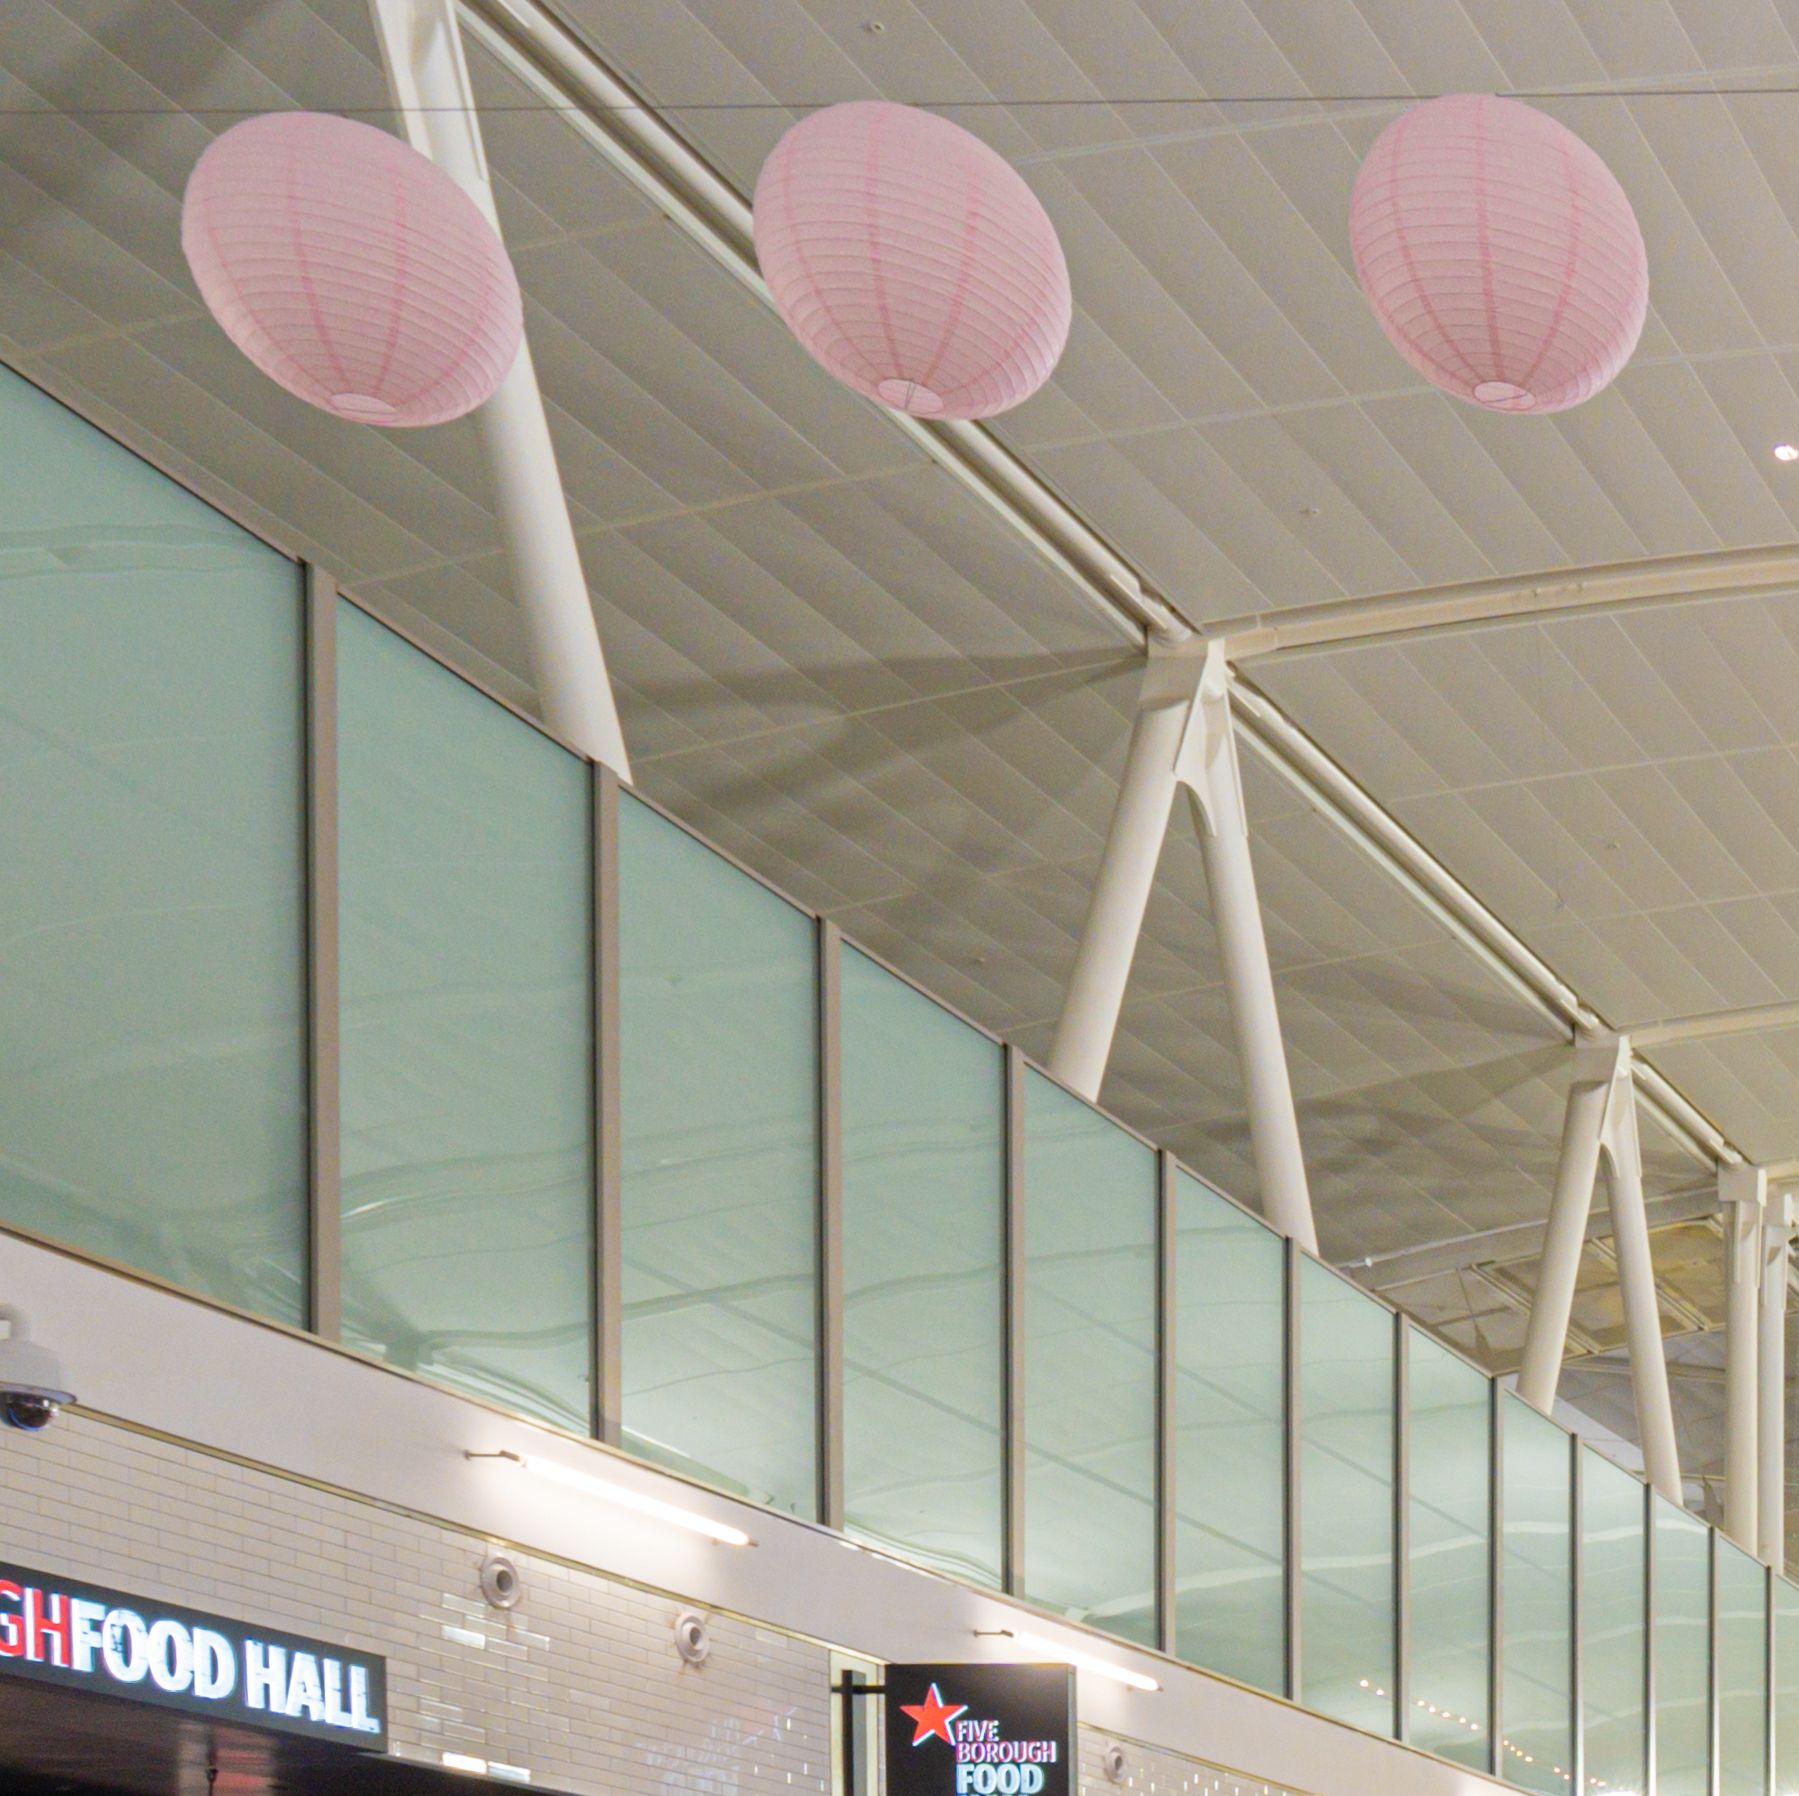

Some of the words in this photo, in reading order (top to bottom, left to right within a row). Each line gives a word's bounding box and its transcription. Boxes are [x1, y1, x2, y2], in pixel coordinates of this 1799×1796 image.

[245, 1640, 380, 1733] HALL
[956, 1720, 999, 1742] FIVE
[956, 1741, 1057, 1763] BOROUGH
[956, 1763, 1044, 1794] FOOD
